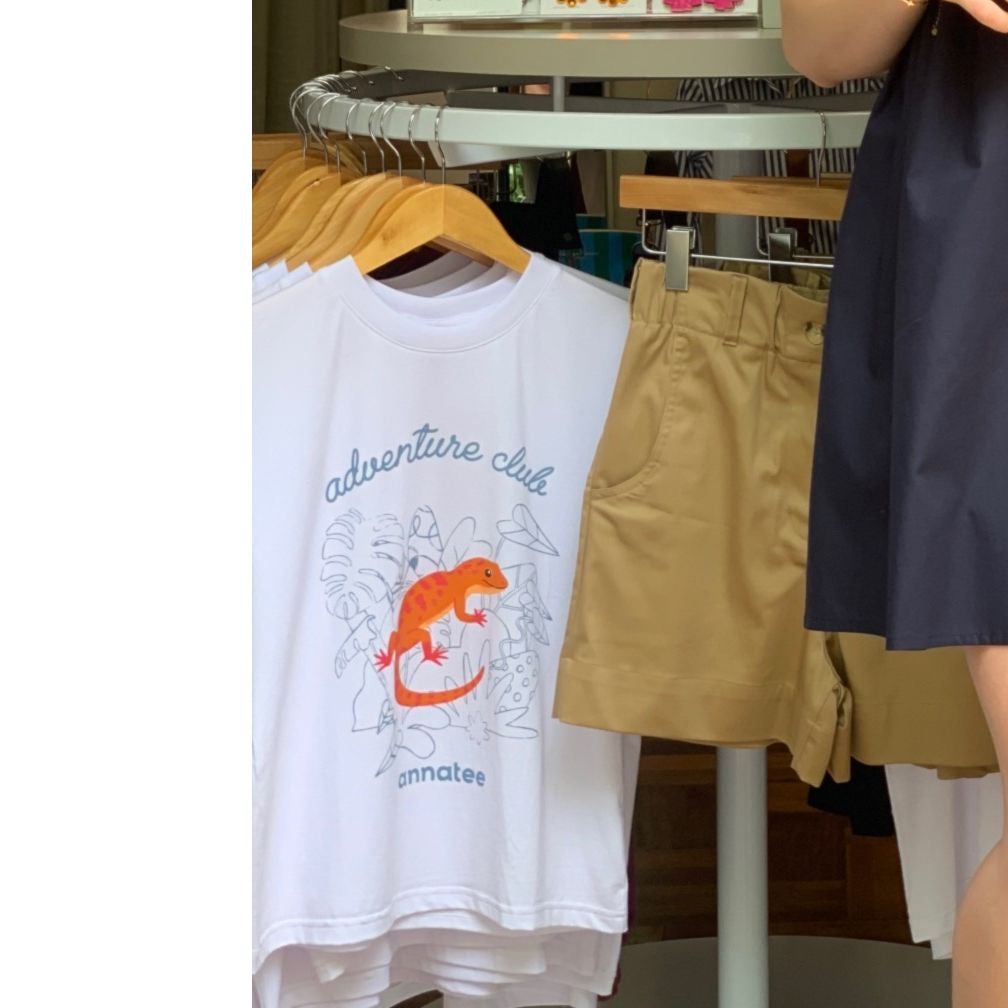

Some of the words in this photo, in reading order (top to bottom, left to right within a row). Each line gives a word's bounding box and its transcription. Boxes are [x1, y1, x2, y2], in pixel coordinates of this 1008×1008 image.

[325, 423, 484, 503] adventure
[491, 446, 555, 496] club
[398, 761, 486, 789] annatee
